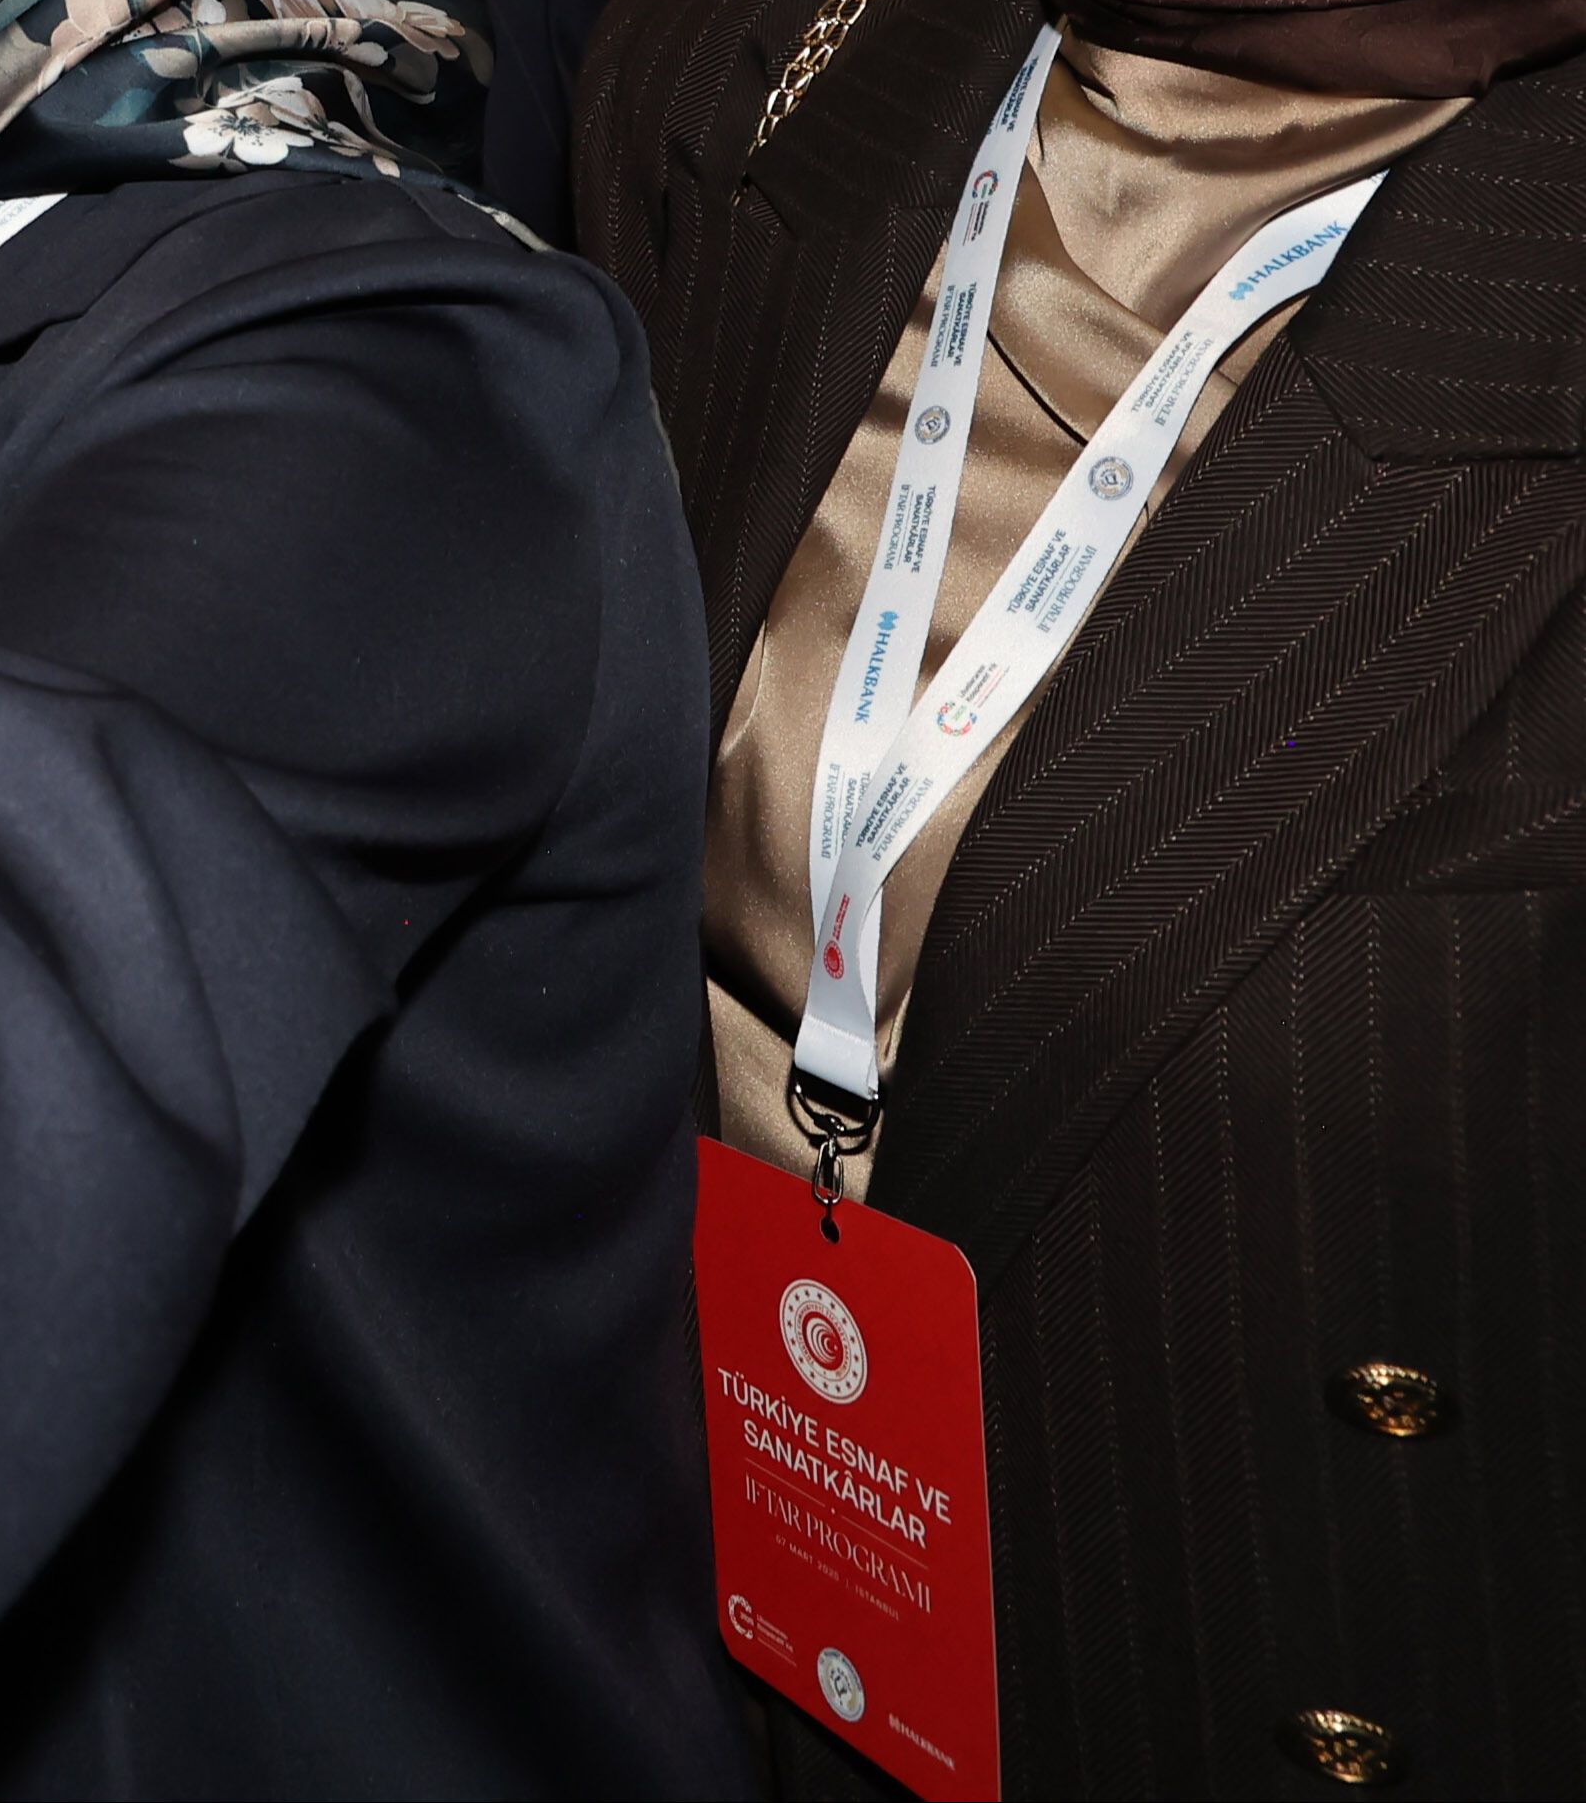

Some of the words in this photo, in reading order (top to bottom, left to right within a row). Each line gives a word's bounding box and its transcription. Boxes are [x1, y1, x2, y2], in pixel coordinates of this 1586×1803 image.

[1247, 221, 1348, 284] HALKBANK
[1006, 573, 1038, 614] TÜRKİYE
[1032, 543, 1055, 575] ESNAF
[1052, 528, 1066, 542] VE
[1025, 544, 1070, 612] SANATKÂRLAR
[1059, 545, 1097, 606] PROGRAMI
[855, 632, 891, 724] HALKBANK
[717, 1366, 820, 1450] TÜRKİYE
[825, 1427, 909, 1495] ESNAF
[915, 1478, 952, 1525] VE
[743, 1419, 927, 1549] SANATKÂRLAR
[807, 1512, 931, 1614] PROGRAMI
